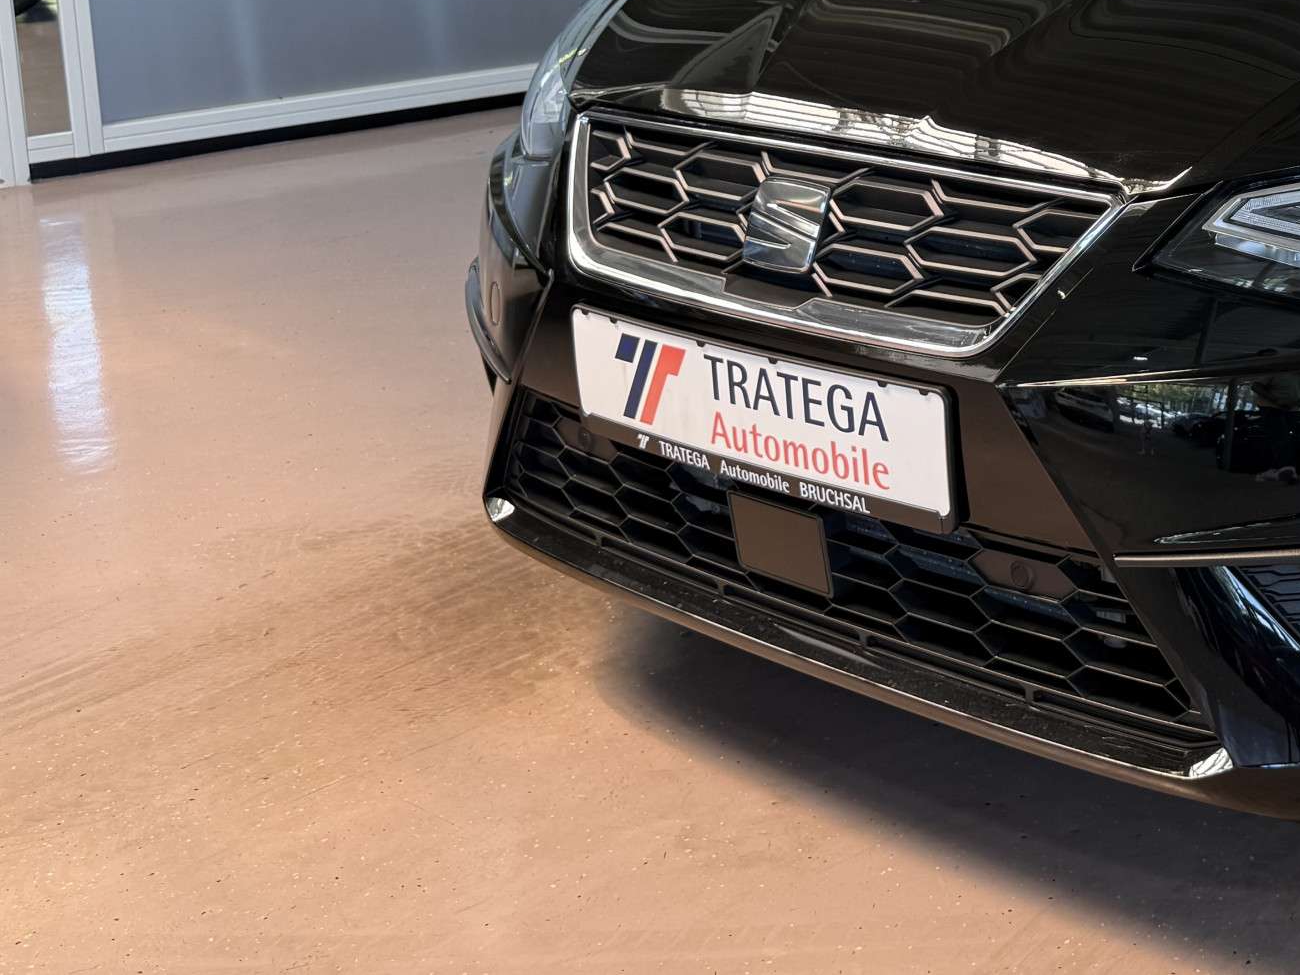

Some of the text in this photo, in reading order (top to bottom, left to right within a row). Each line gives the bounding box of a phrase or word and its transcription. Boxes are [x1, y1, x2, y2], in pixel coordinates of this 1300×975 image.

[703, 353, 890, 442] TRATEGA
[658, 440, 871, 514] TRATEGA Automobile BRUCHSAL
[710, 411, 891, 490] Automobile
